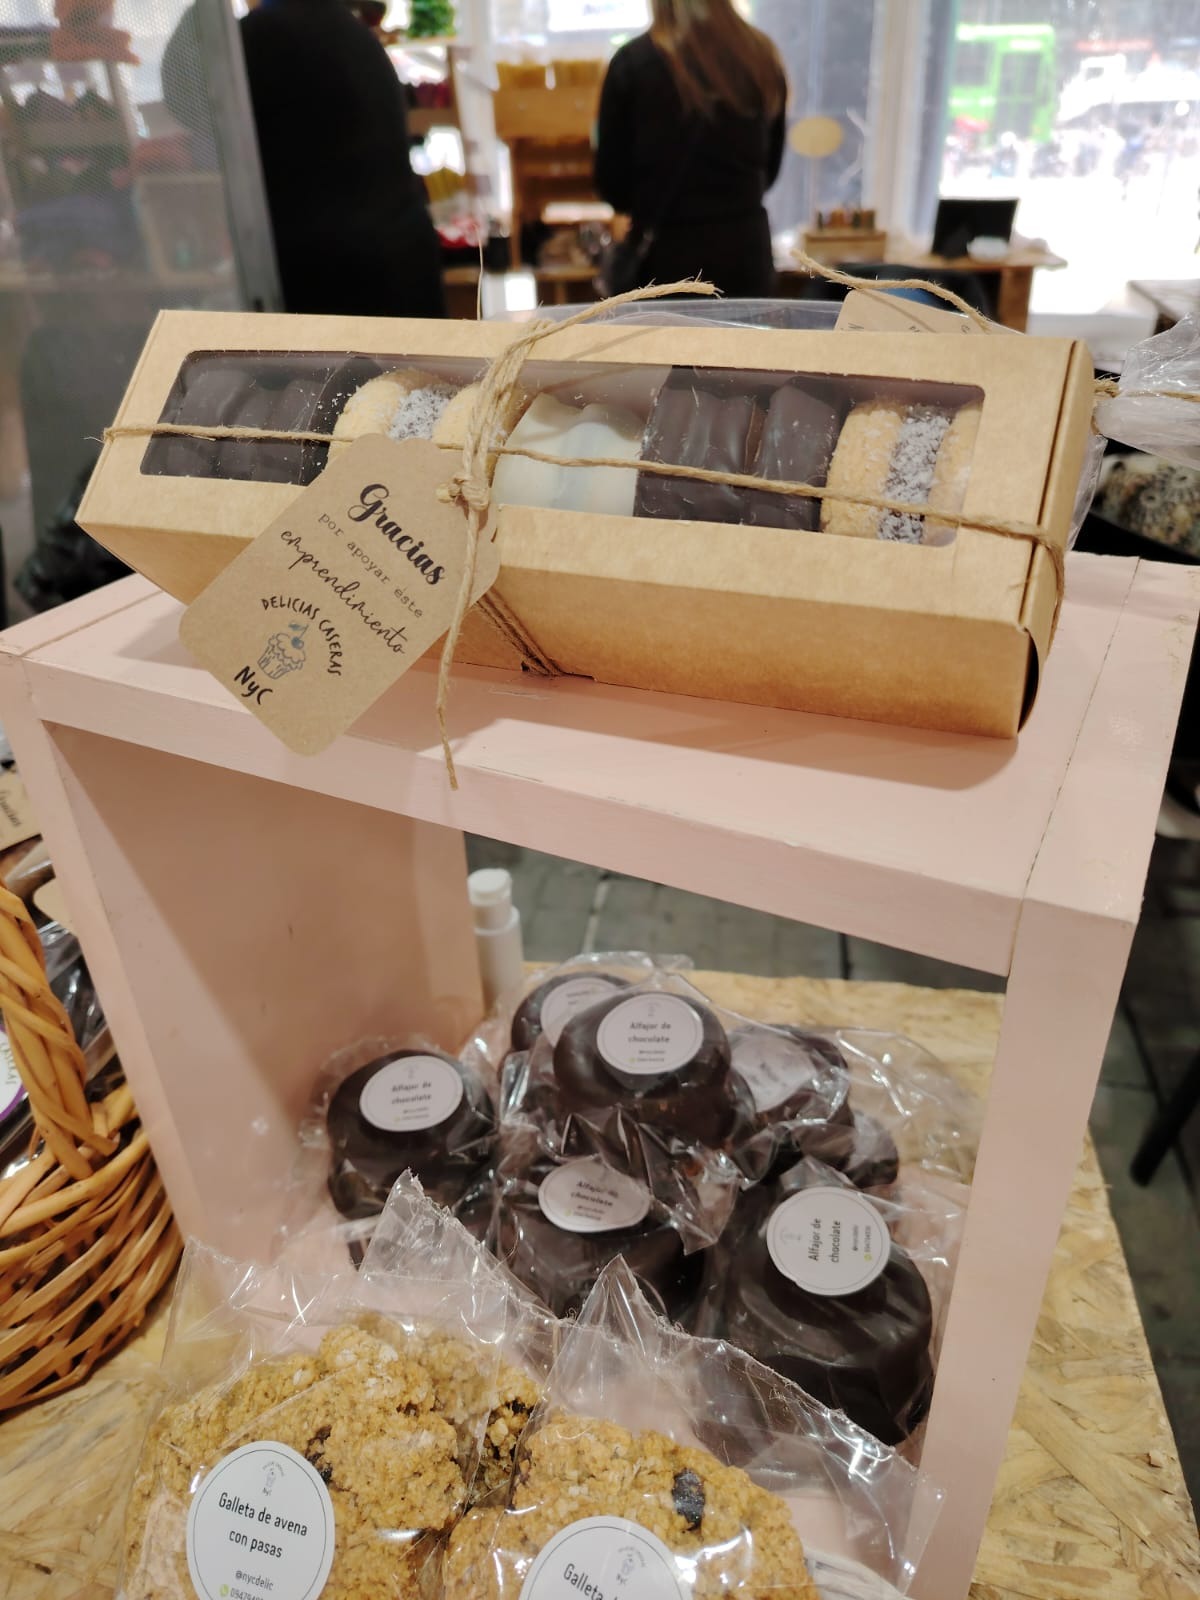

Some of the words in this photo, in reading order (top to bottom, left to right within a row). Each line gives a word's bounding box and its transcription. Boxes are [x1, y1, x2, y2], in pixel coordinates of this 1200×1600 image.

[347, 483, 446, 585] Gracias
[318, 511, 344, 537] por
[346, 540, 391, 585] apoyar
[393, 585, 424, 619] éste
[280, 529, 406, 654] emprendimiento
[260, 595, 320, 621] DELICIAS
[318, 619, 343, 677] CASERAS
[233, 665, 274, 706] NyC
[627, 1035, 671, 1044] chocolate
[629, 1020, 658, 1032] Alfajor
[660, 1021, 672, 1030] de
[810, 1218, 822, 1230] de
[828, 1220, 841, 1263] chocolate
[808, 1231, 823, 1261] Alfajor
[218, 1491, 255, 1520] Galleta
[257, 1507, 272, 1525] de
[273, 1517, 308, 1537] avena
[228, 1529, 248, 1546] con
[249, 1536, 283, 1559] pasas
[563, 1562, 604, 1600] Galleta
